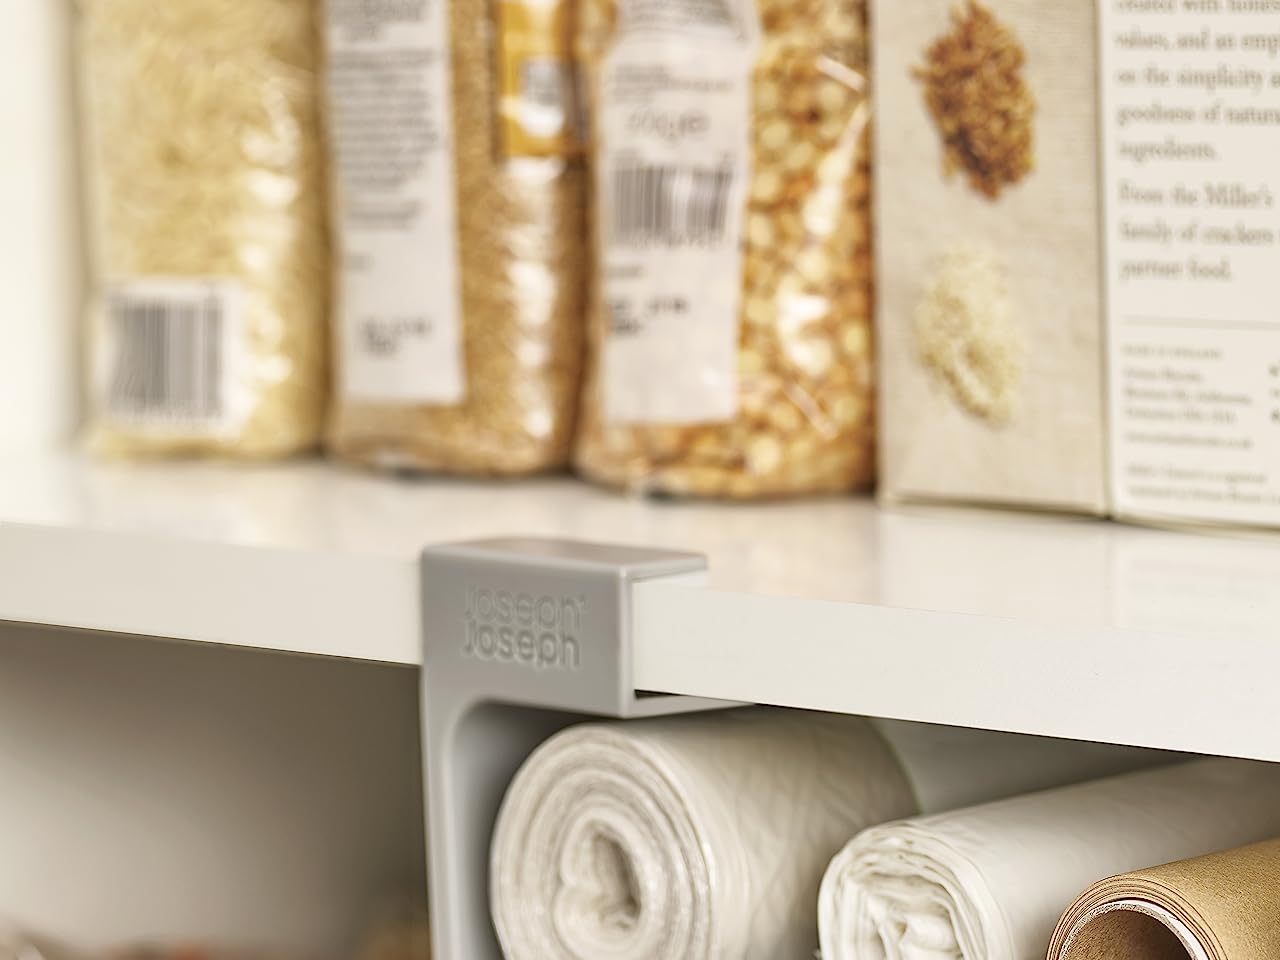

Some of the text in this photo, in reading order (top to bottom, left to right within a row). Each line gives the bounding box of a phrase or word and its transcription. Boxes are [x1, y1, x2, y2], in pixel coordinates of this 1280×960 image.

[1177, 26, 1209, 49] and
[1177, 63, 1263, 94] simplicity
[1204, 100, 1221, 122] of
